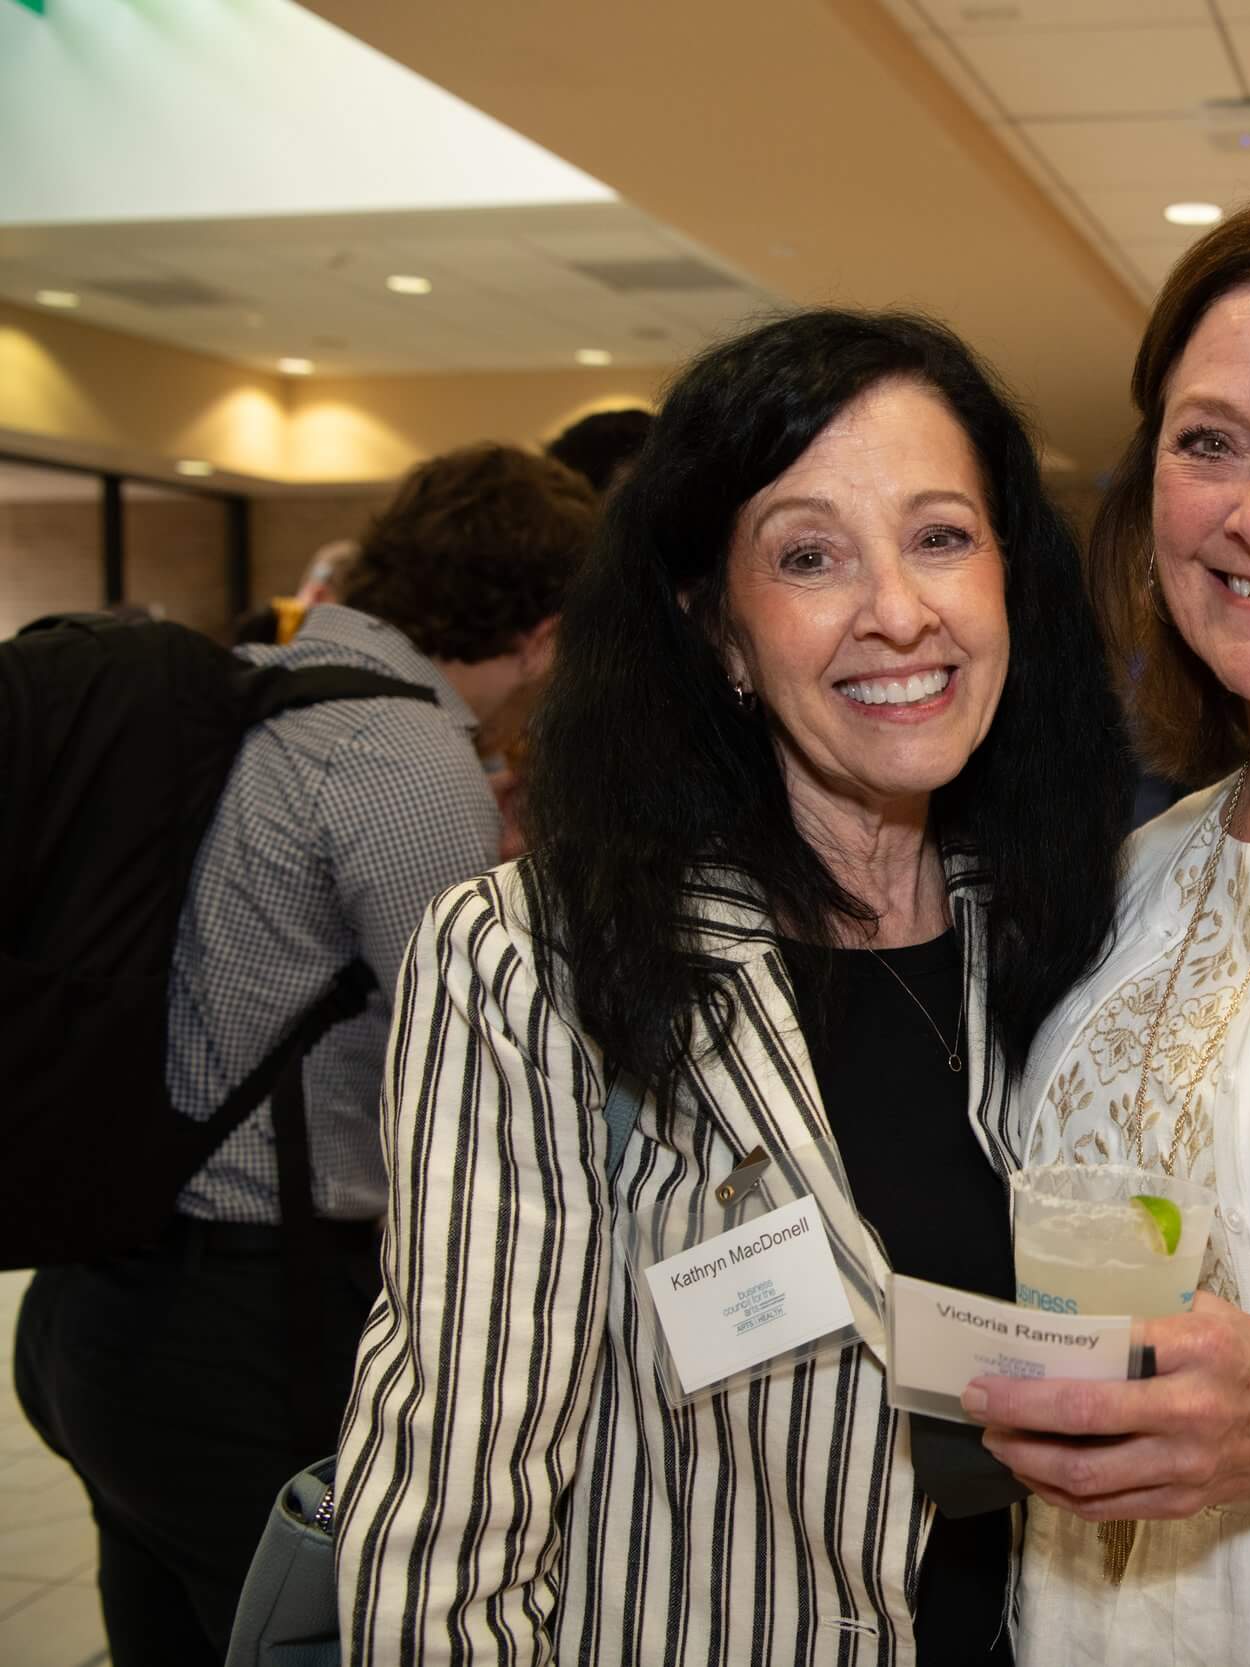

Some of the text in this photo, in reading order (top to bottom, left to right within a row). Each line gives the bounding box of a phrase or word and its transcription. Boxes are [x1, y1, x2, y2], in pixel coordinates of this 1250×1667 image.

[671, 1216, 810, 1291] Kathryn MacDonell
[737, 1280, 774, 1301] business
[1016, 1283, 1078, 1315] usiness
[936, 1302, 1100, 1350] Victoria Ramsey
